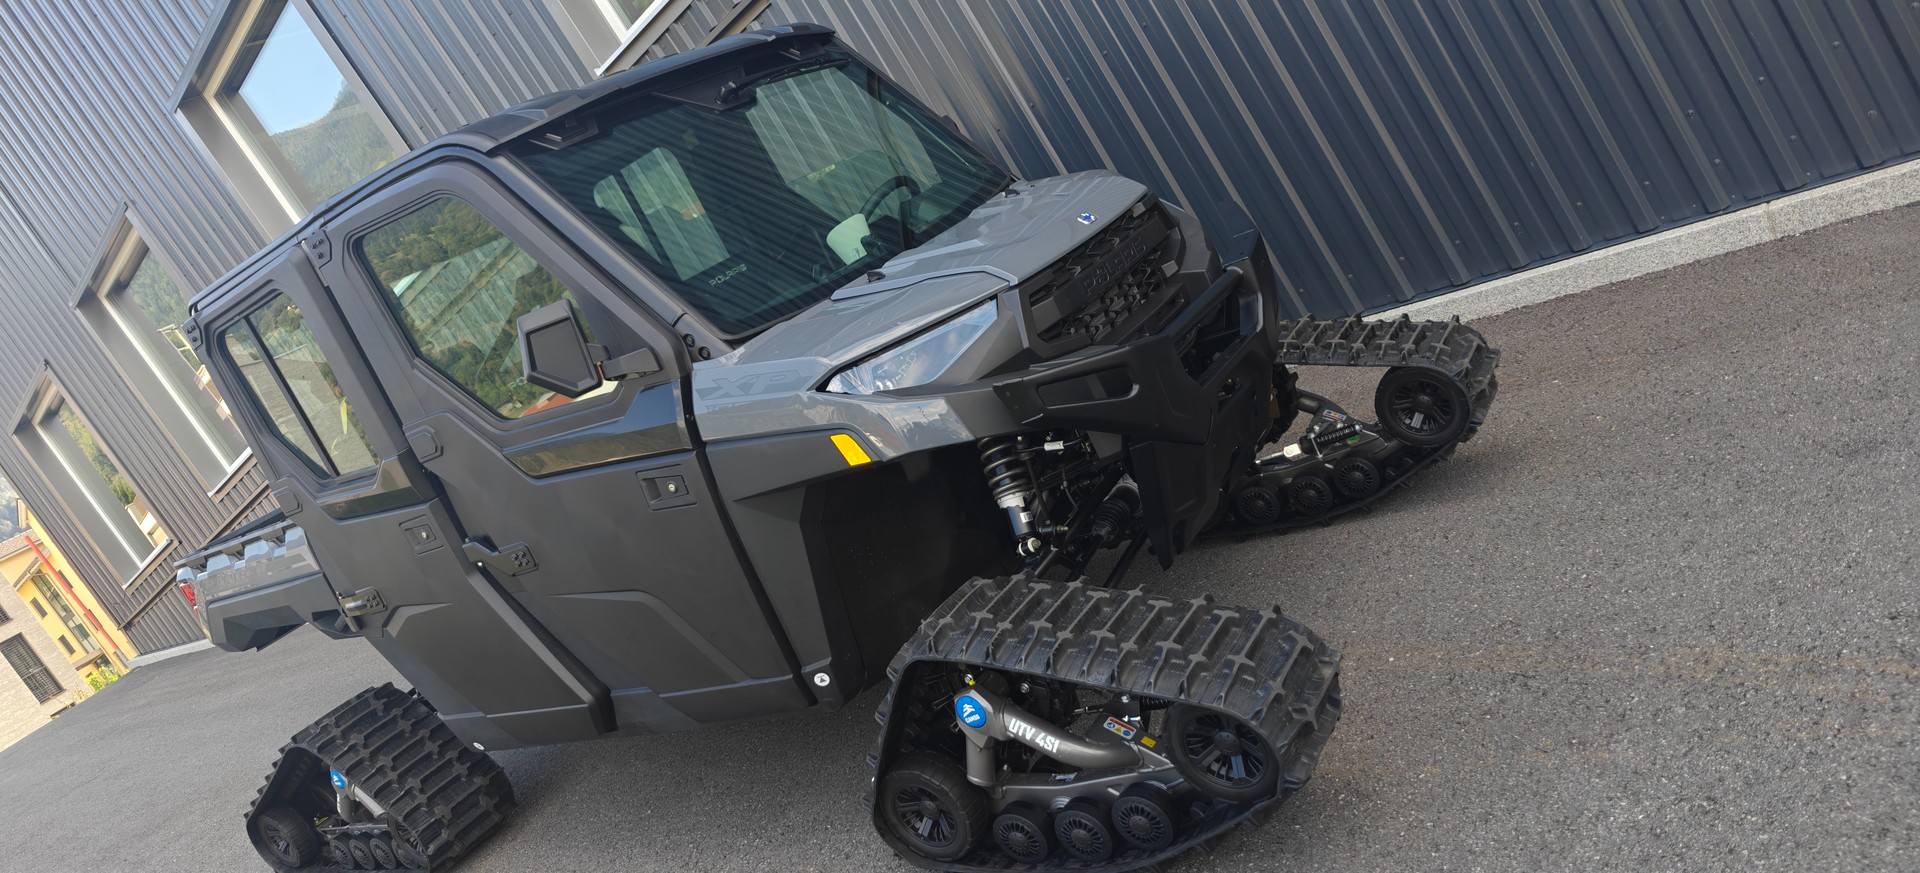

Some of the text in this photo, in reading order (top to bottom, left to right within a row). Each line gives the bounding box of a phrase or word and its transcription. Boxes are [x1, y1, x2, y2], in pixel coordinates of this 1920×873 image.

[709, 263, 747, 287] POLARIS
[1083, 237, 1146, 297] POLARIS
[702, 369, 803, 401] XP
[1008, 718, 1036, 741] UTV
